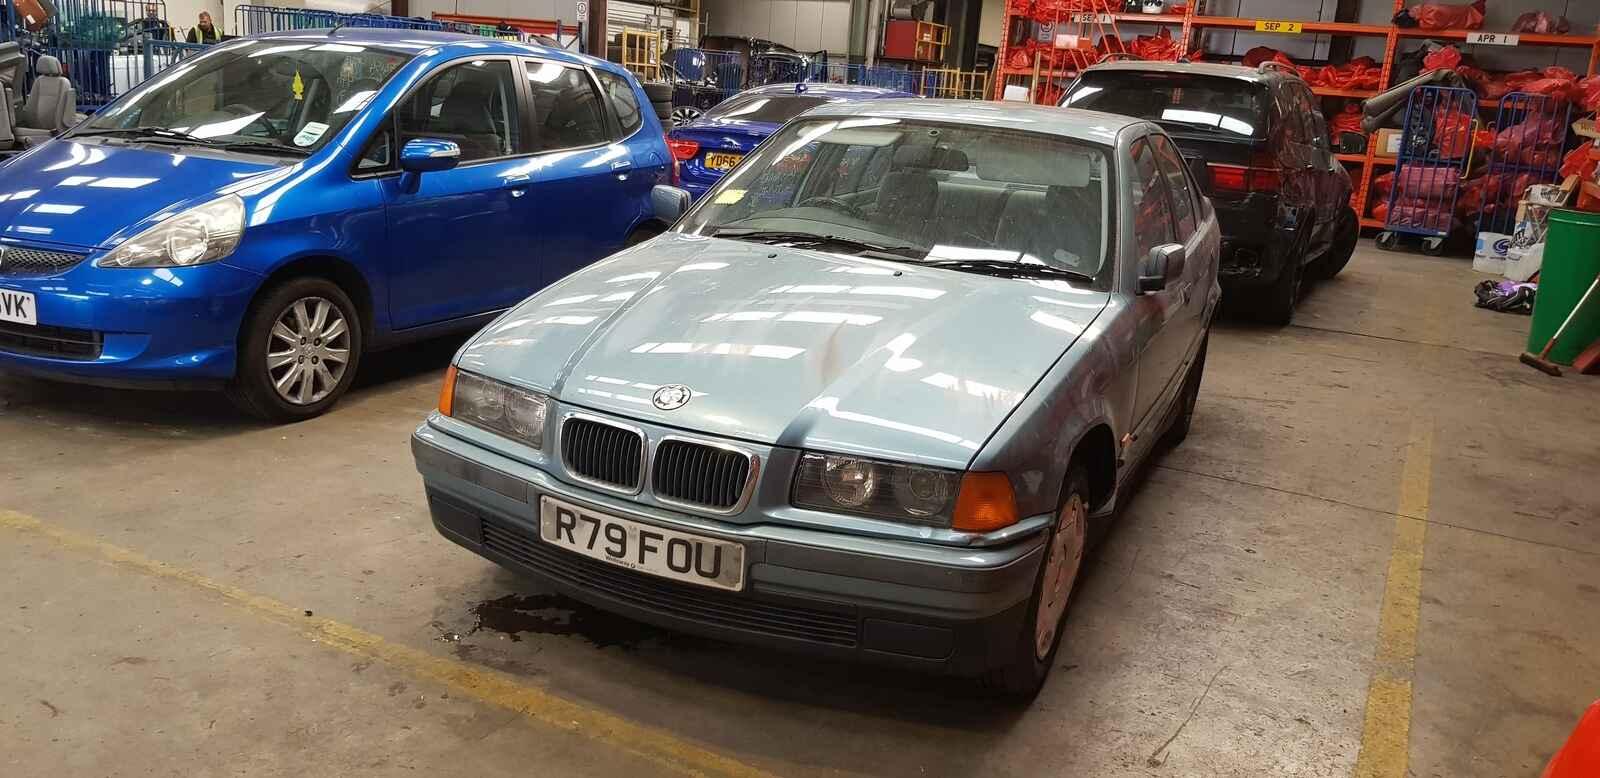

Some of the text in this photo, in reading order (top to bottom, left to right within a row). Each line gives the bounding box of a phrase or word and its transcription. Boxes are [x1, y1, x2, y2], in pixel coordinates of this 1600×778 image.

[1264, 22, 1295, 32] SEP 2
[1477, 34, 1496, 43] APR
[710, 154, 736, 168] YD66
[0, 292, 27, 318] VK
[555, 506, 722, 579] R79 FOU
